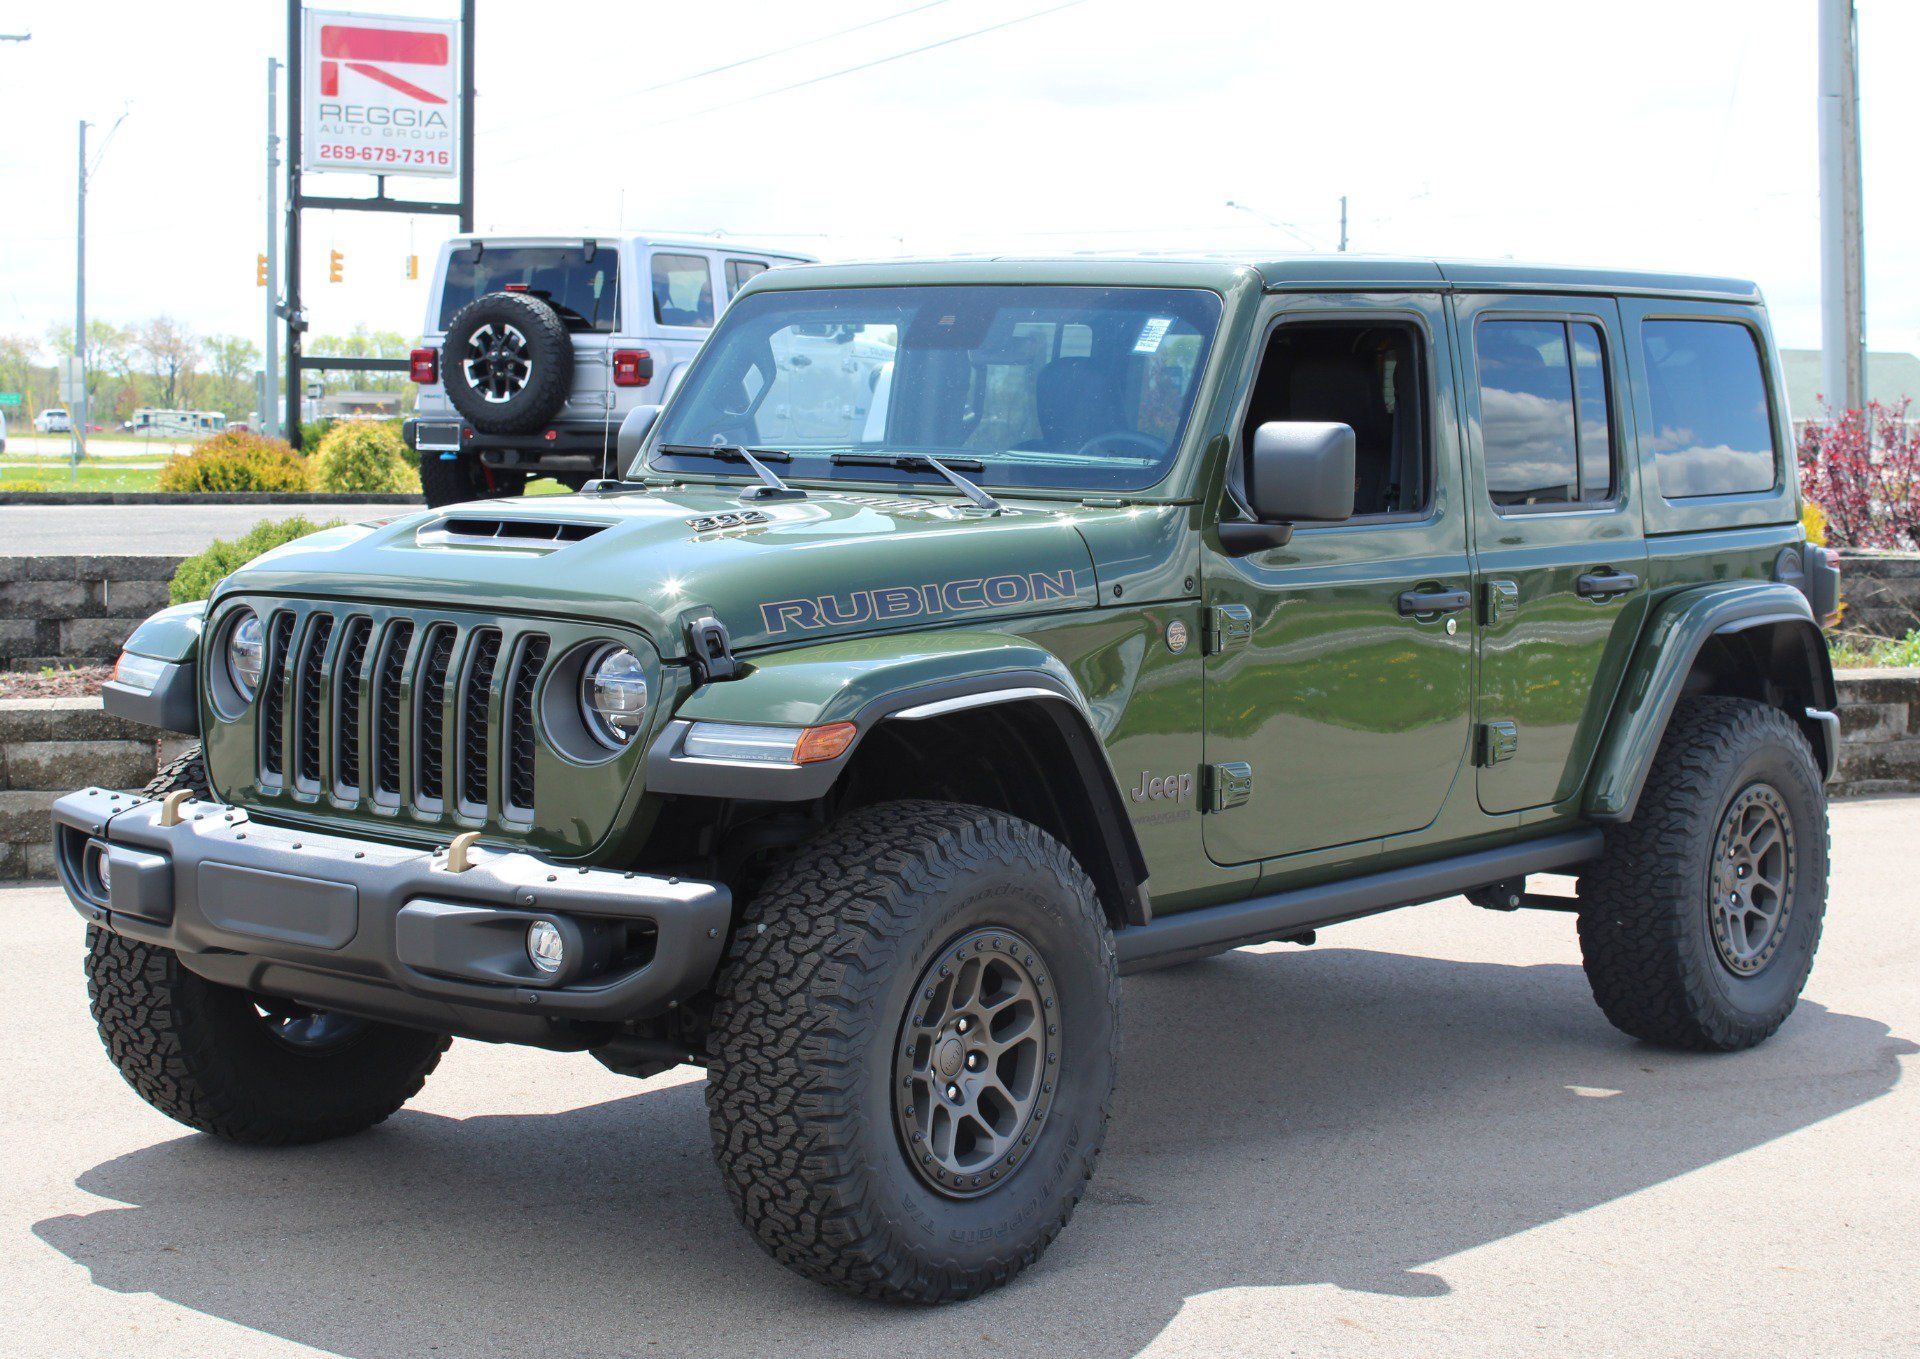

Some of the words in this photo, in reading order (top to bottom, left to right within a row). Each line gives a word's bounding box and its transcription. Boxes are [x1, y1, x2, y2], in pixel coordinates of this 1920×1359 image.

[319, 103, 448, 129] REGGIA
[320, 124, 372, 136] AUTO
[382, 128, 449, 140] GROUP
[320, 144, 449, 165] 269-679-7316
[685, 511, 769, 532] 392
[759, 569, 1078, 635] RUBICON
[1131, 770, 1192, 804] Jeep
